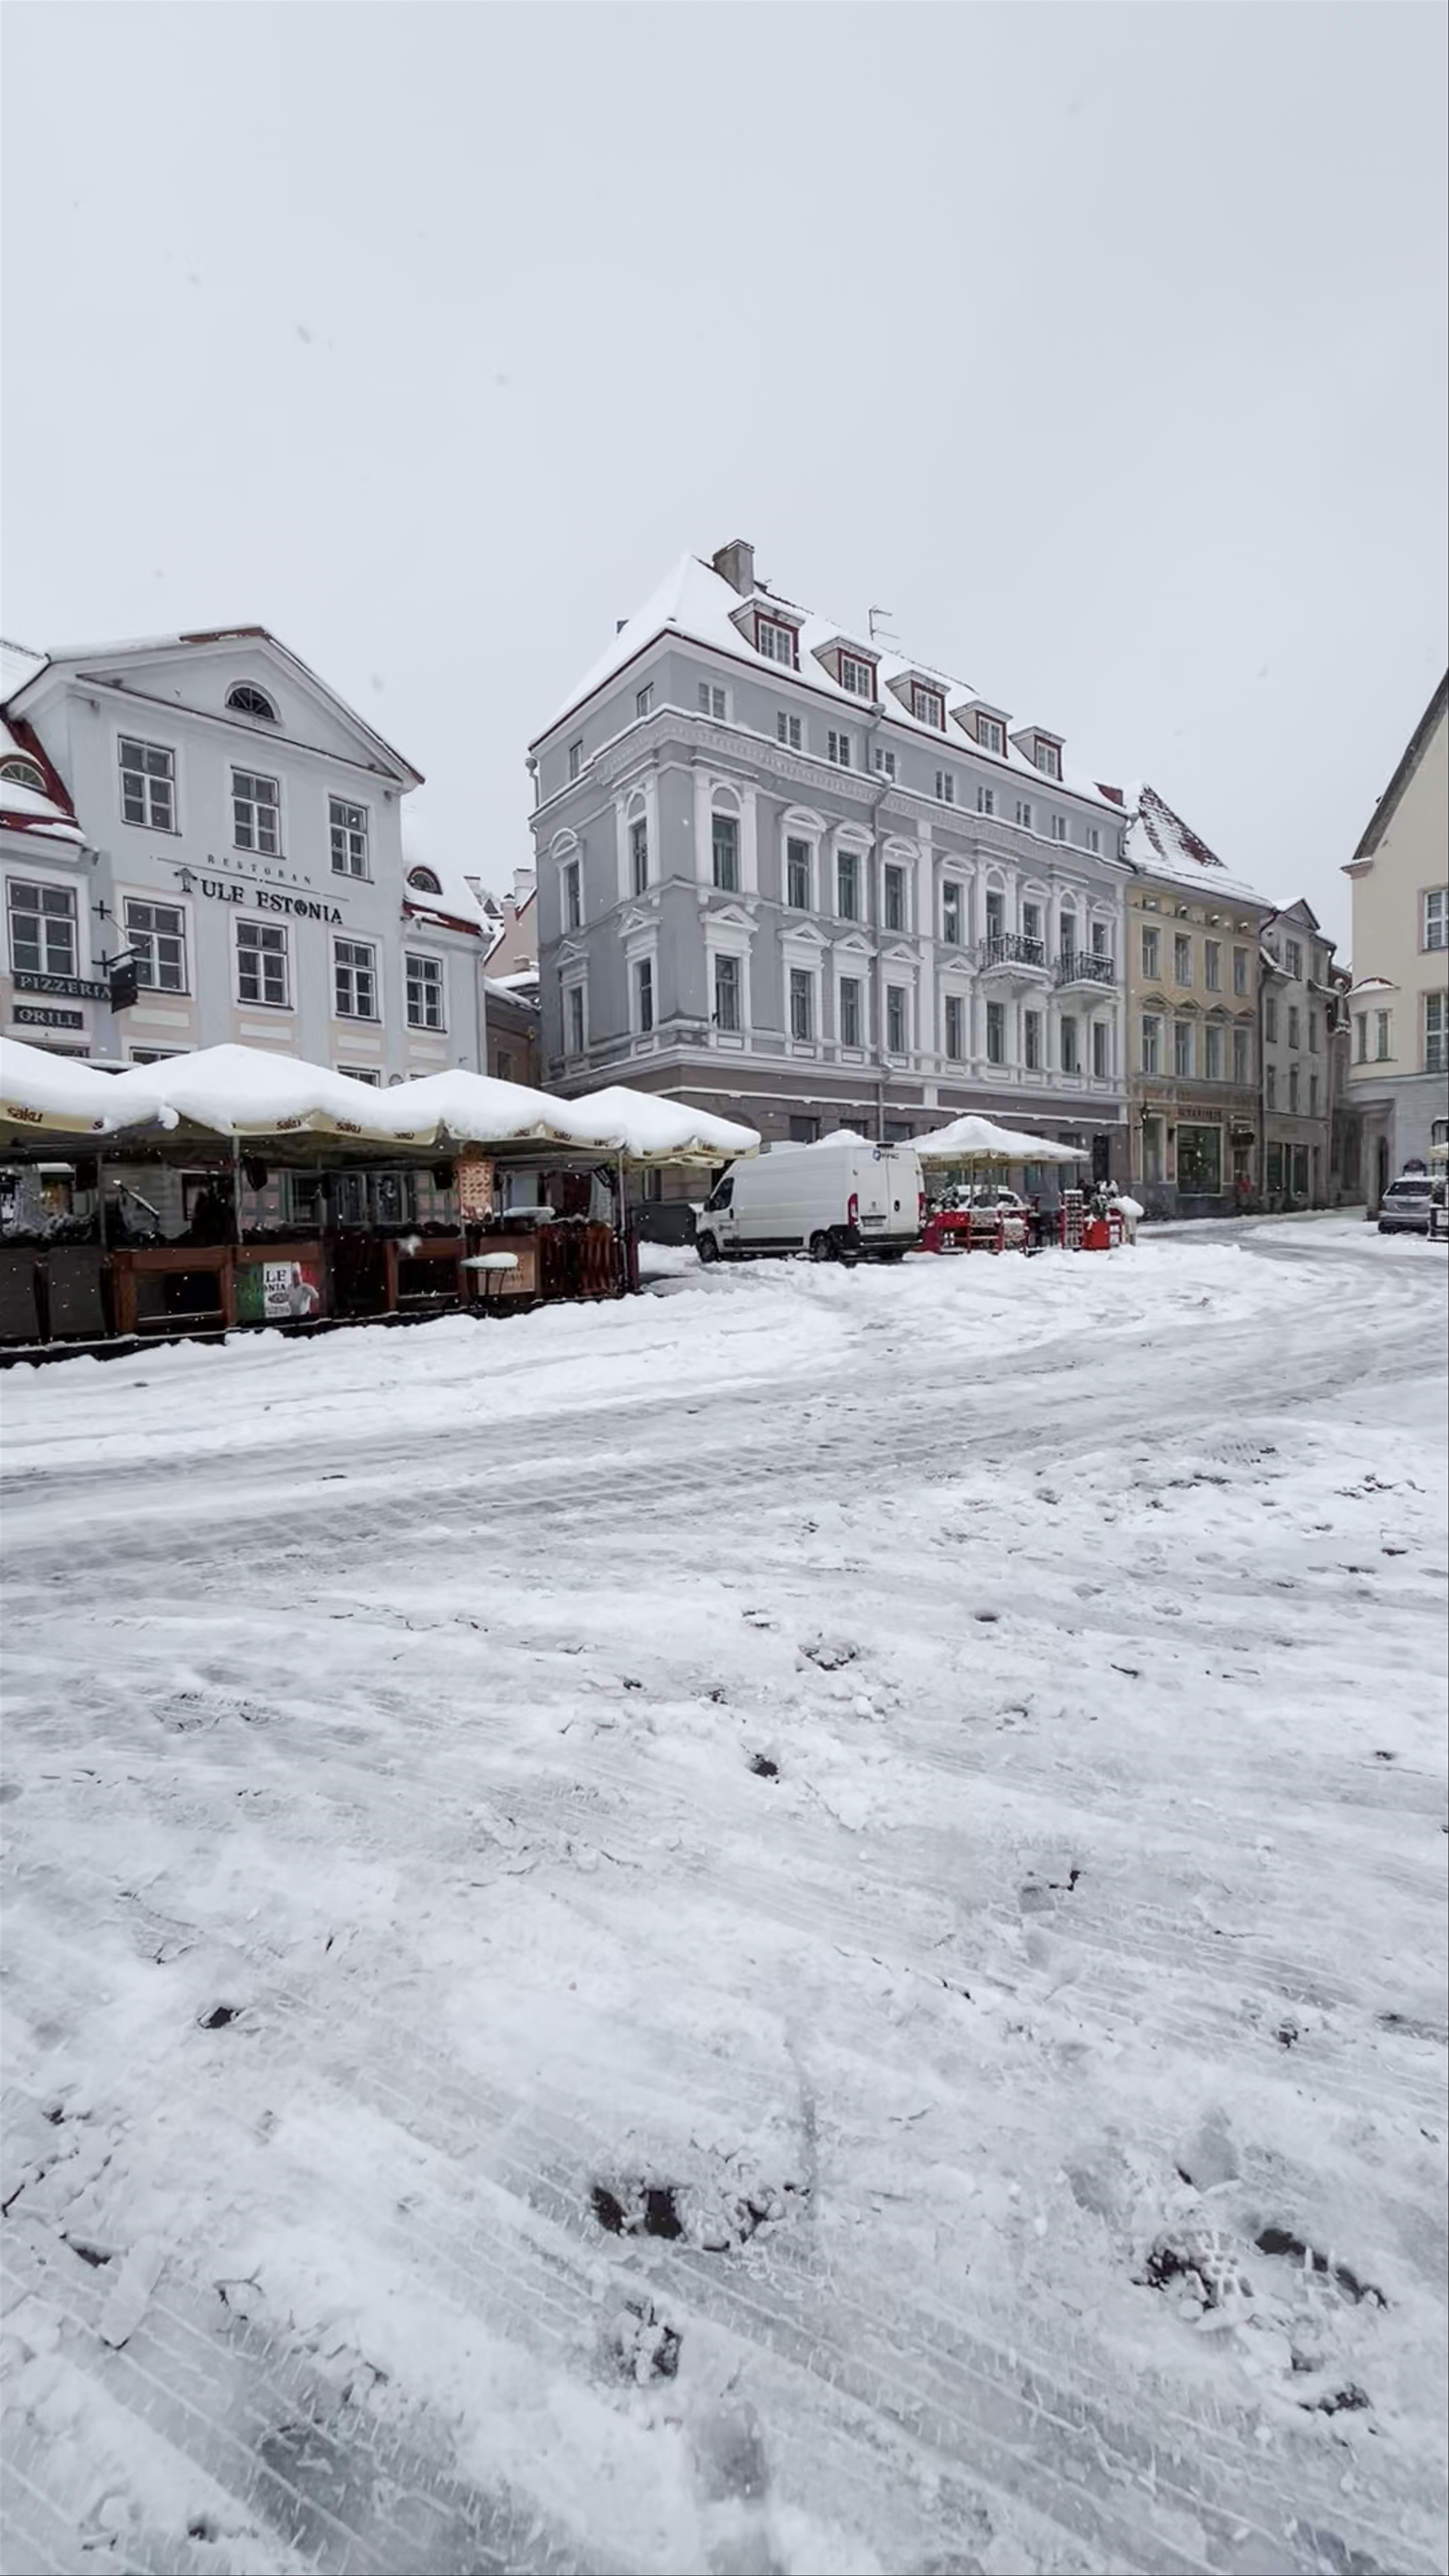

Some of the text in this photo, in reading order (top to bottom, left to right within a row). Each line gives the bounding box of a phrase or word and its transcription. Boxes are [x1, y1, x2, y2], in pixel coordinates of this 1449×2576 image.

[208, 854, 311, 884] RESTORAN
[256, 890, 343, 924] ESTONIA
[20, 976, 112, 999] PIZZERIA
